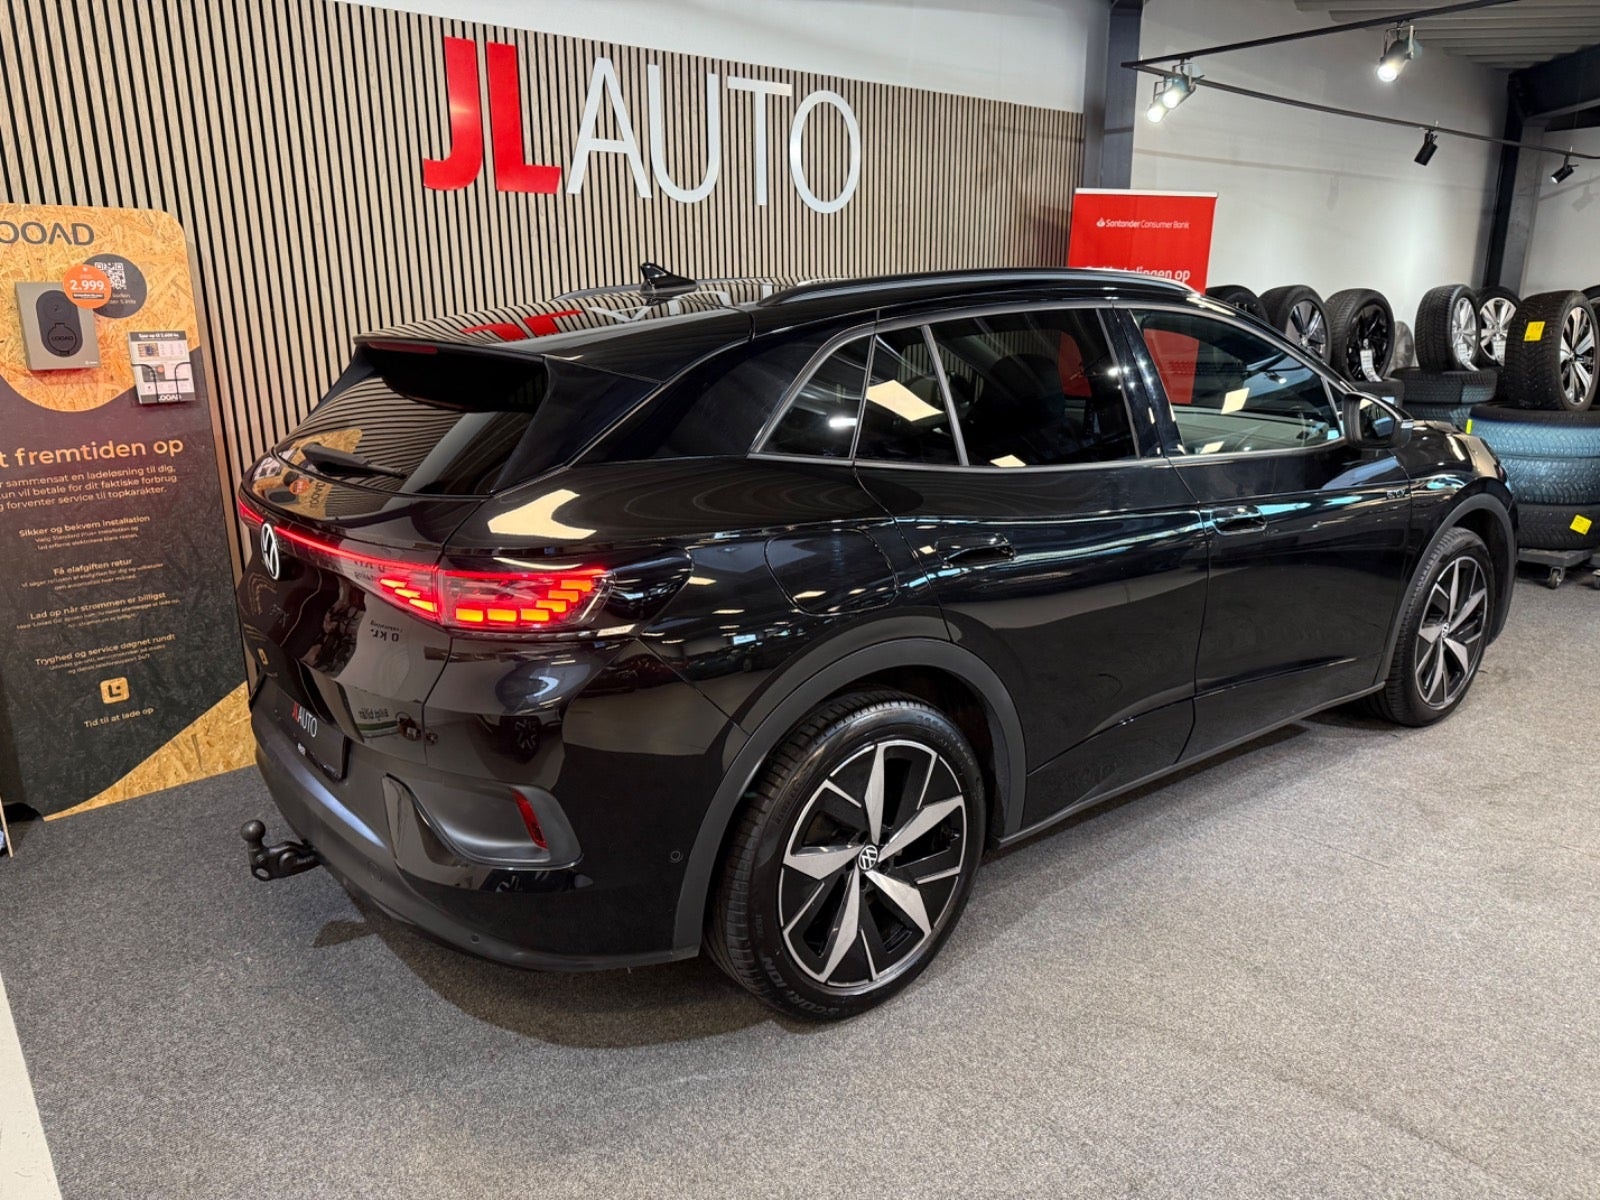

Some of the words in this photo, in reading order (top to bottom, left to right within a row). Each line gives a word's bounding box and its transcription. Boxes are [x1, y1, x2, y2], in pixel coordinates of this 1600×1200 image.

[15, 440, 146, 466] fremtiden
[153, 438, 184, 457] op
[0, 491, 16, 499] un
[18, 488, 30, 497] vil
[33, 485, 66, 496] betale
[68, 484, 82, 492] for
[85, 481, 98, 490] dit
[101, 478, 139, 489] faktiske
[141, 475, 178, 485] forbrug
[6, 475, 68, 488] sammensat
[71, 473, 85, 481] en
[146, 465, 156, 474] til
[7, 498, 55, 510] forventer
[58, 493, 94, 504] service
[95, 491, 106, 500] til
[19, 528, 48, 538] Sikker
[50, 526, 62, 534] og
[30, 610, 47, 620] Lad
[49, 609, 61, 618] op
[35, 652, 72, 666] Tryghed
[75, 651, 86, 659] og
[88, 644, 118, 656] service
[83, 719, 98, 728] Tid
[100, 716, 110, 725] til
[111, 715, 120, 723] at
[122, 709, 141, 720] lade
[142, 707, 154, 717] op
